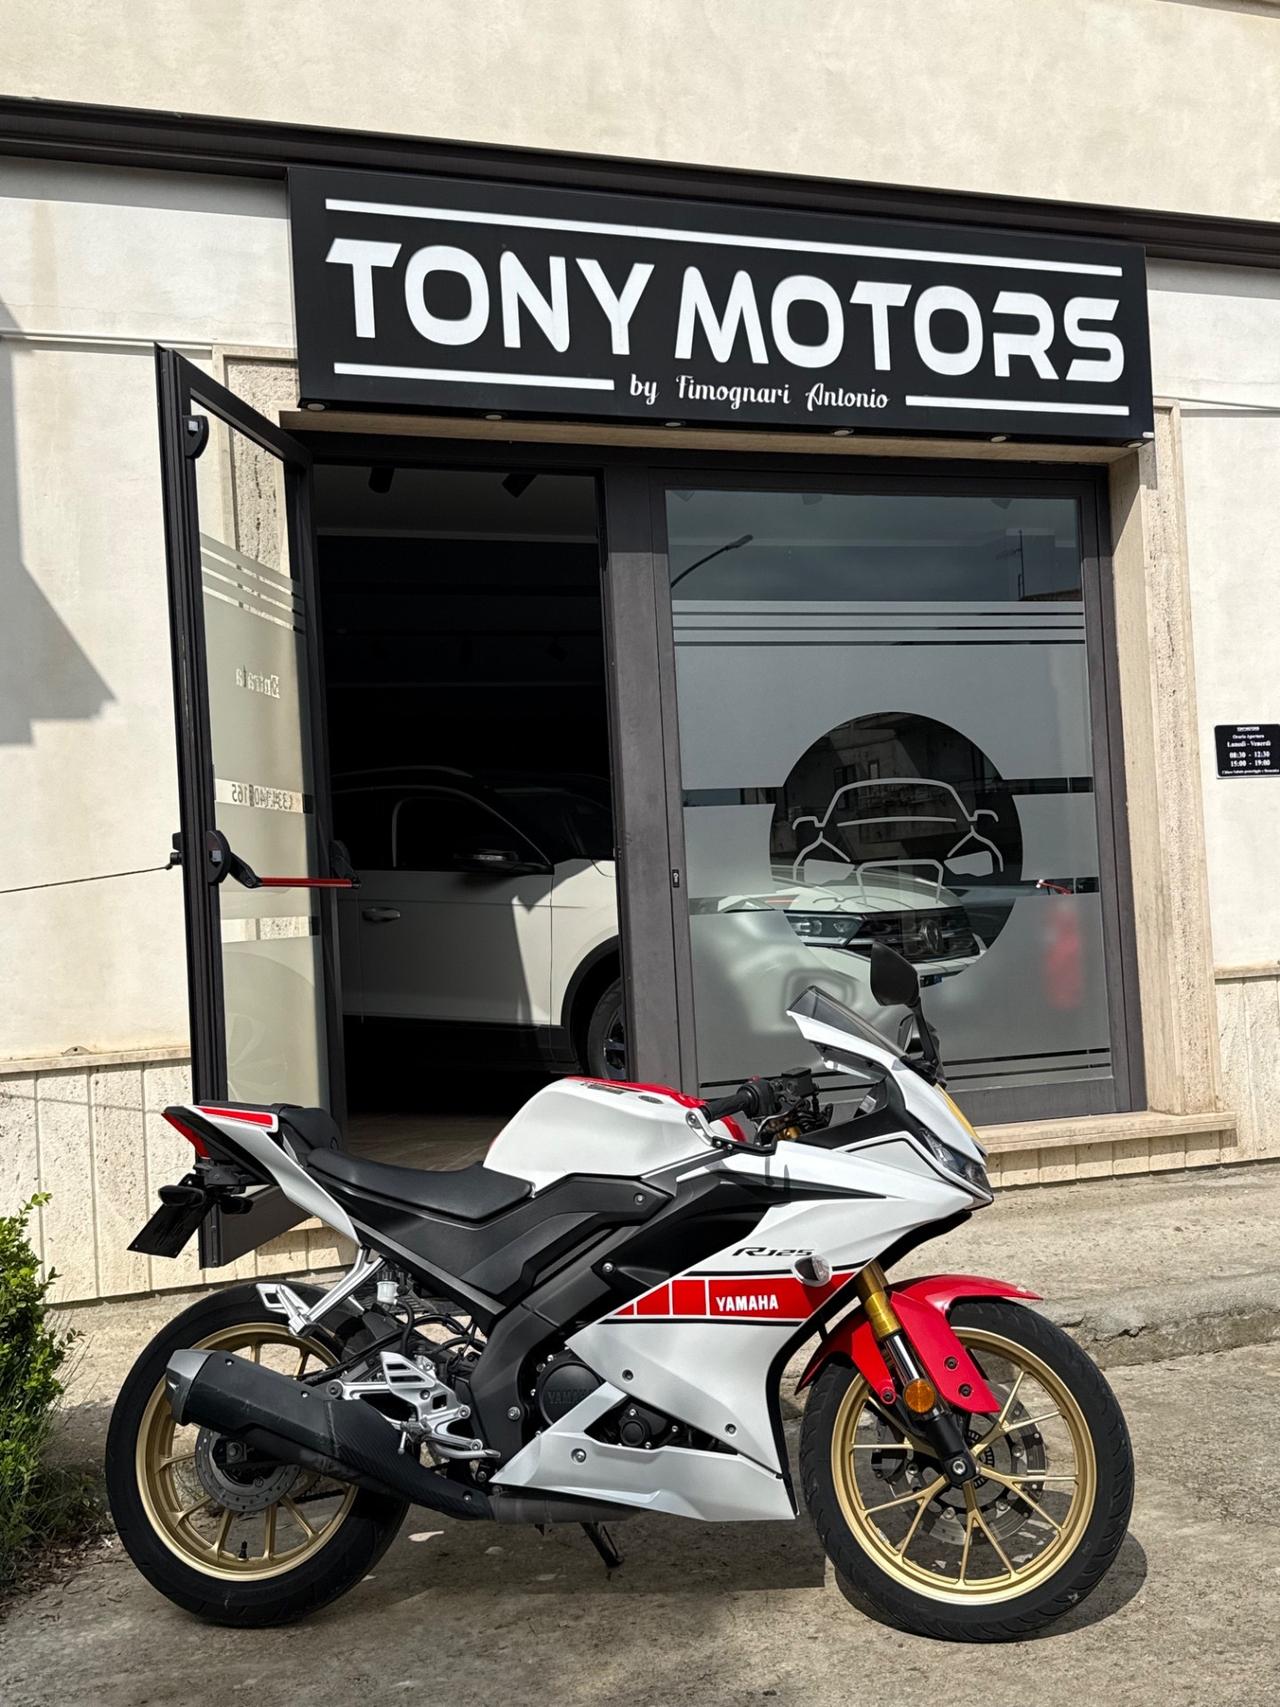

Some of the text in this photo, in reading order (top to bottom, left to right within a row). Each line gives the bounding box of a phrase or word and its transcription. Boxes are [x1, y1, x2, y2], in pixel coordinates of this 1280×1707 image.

[325, 237, 1125, 383] TONY MOTORS
[629, 373, 659, 405] by
[805, 383, 889, 411] Antonio
[715, 1294, 779, 1312] YAMAHA
